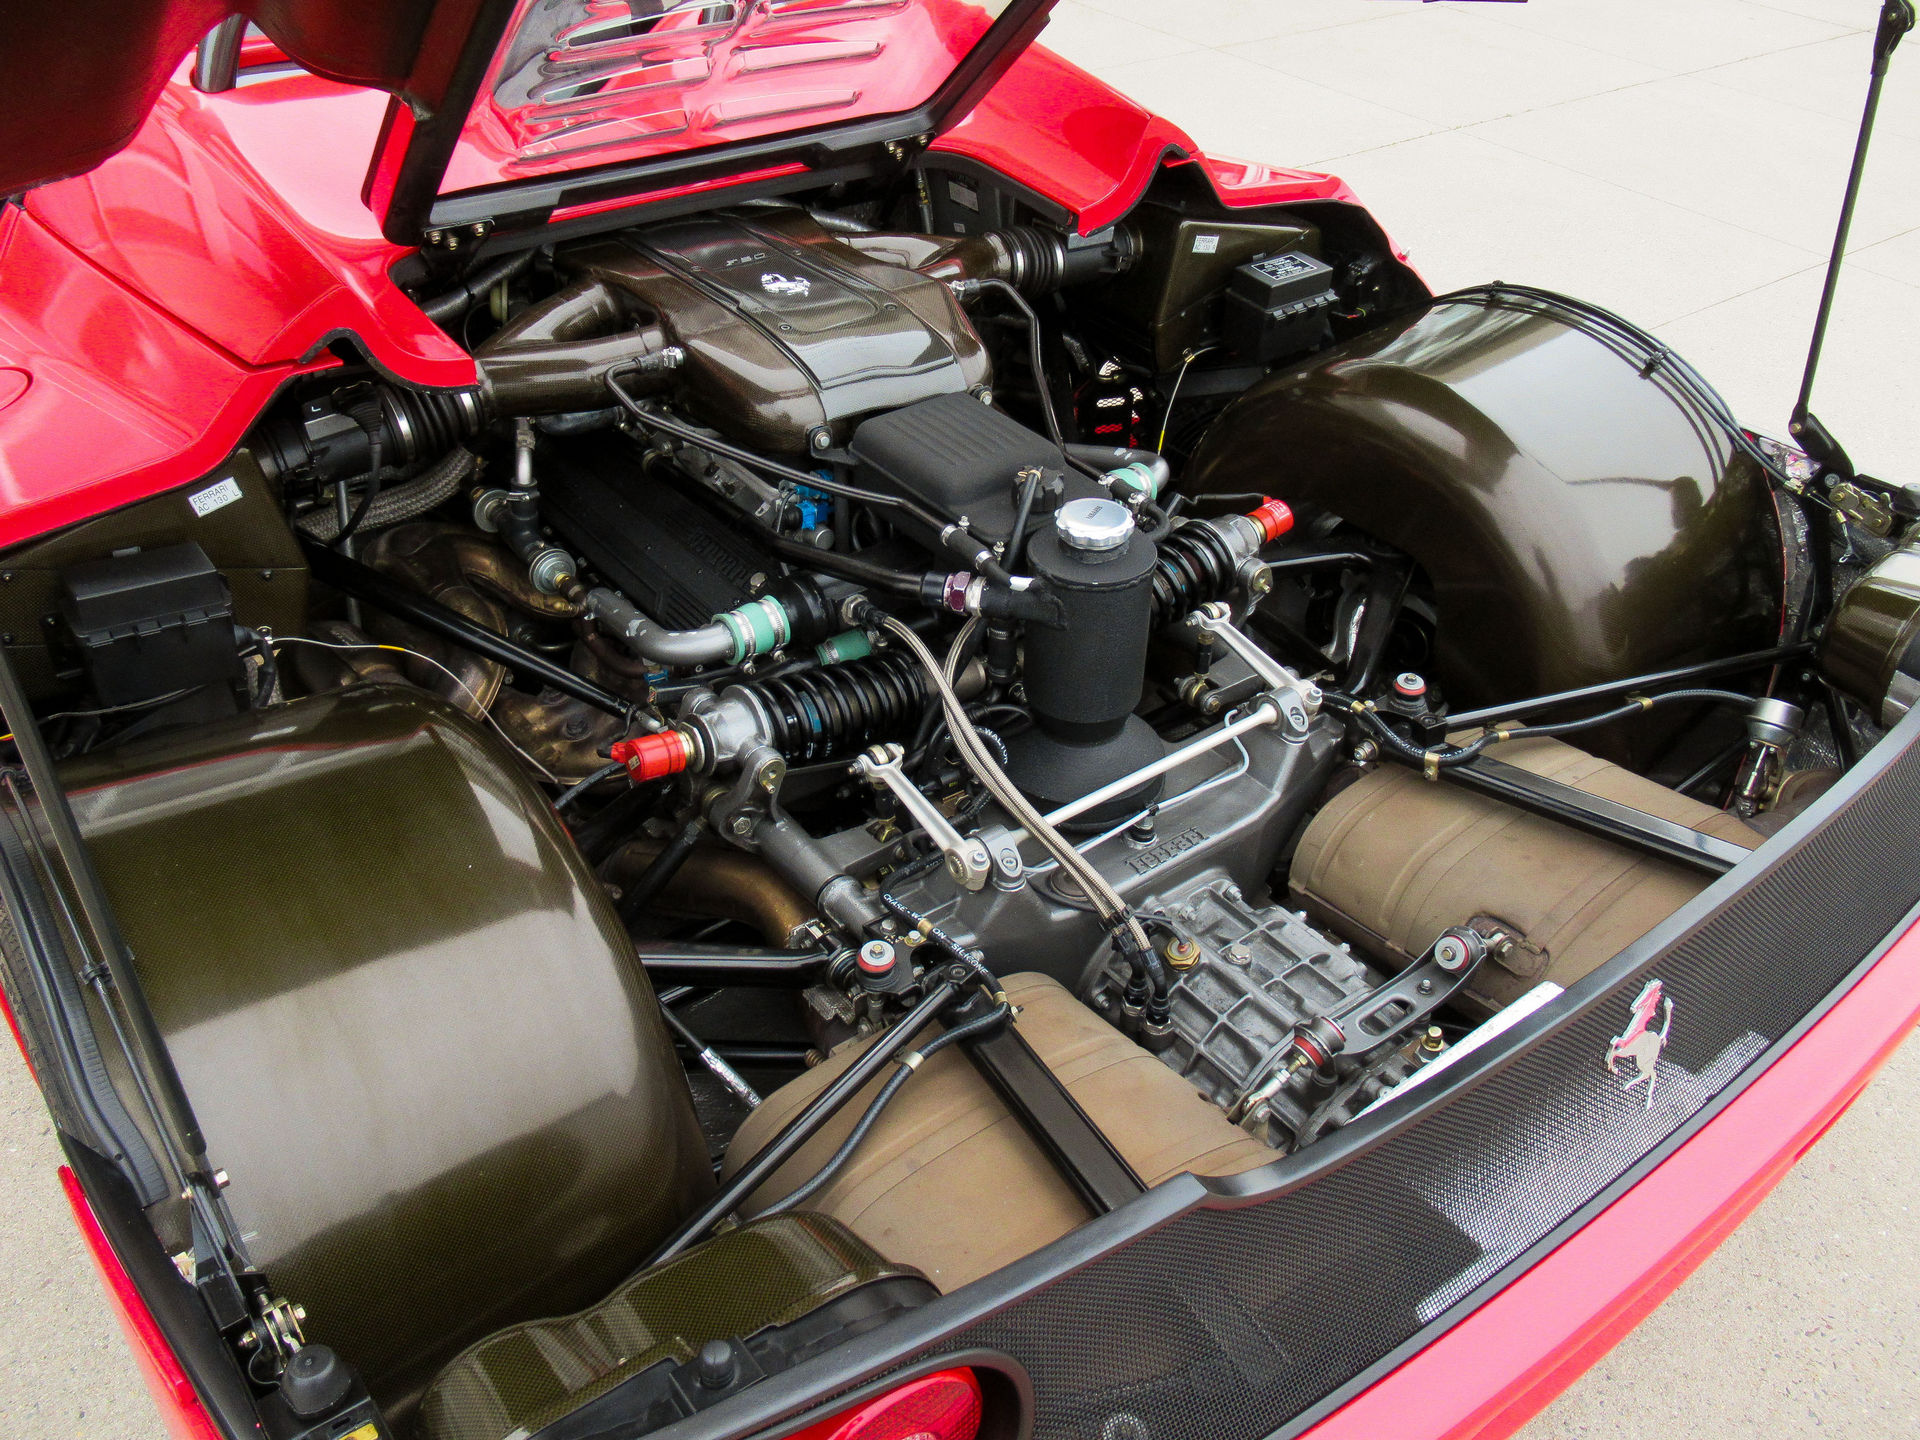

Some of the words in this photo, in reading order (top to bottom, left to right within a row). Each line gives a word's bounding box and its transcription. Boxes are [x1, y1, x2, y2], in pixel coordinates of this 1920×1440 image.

[193, 484, 229, 506] FERRARI
[198, 502, 210, 514] AC
[213, 494, 229, 506] 130
[232, 489, 240, 497] L
[883, 893, 908, 912] CHASE
[951, 943, 989, 975] SILICONE
